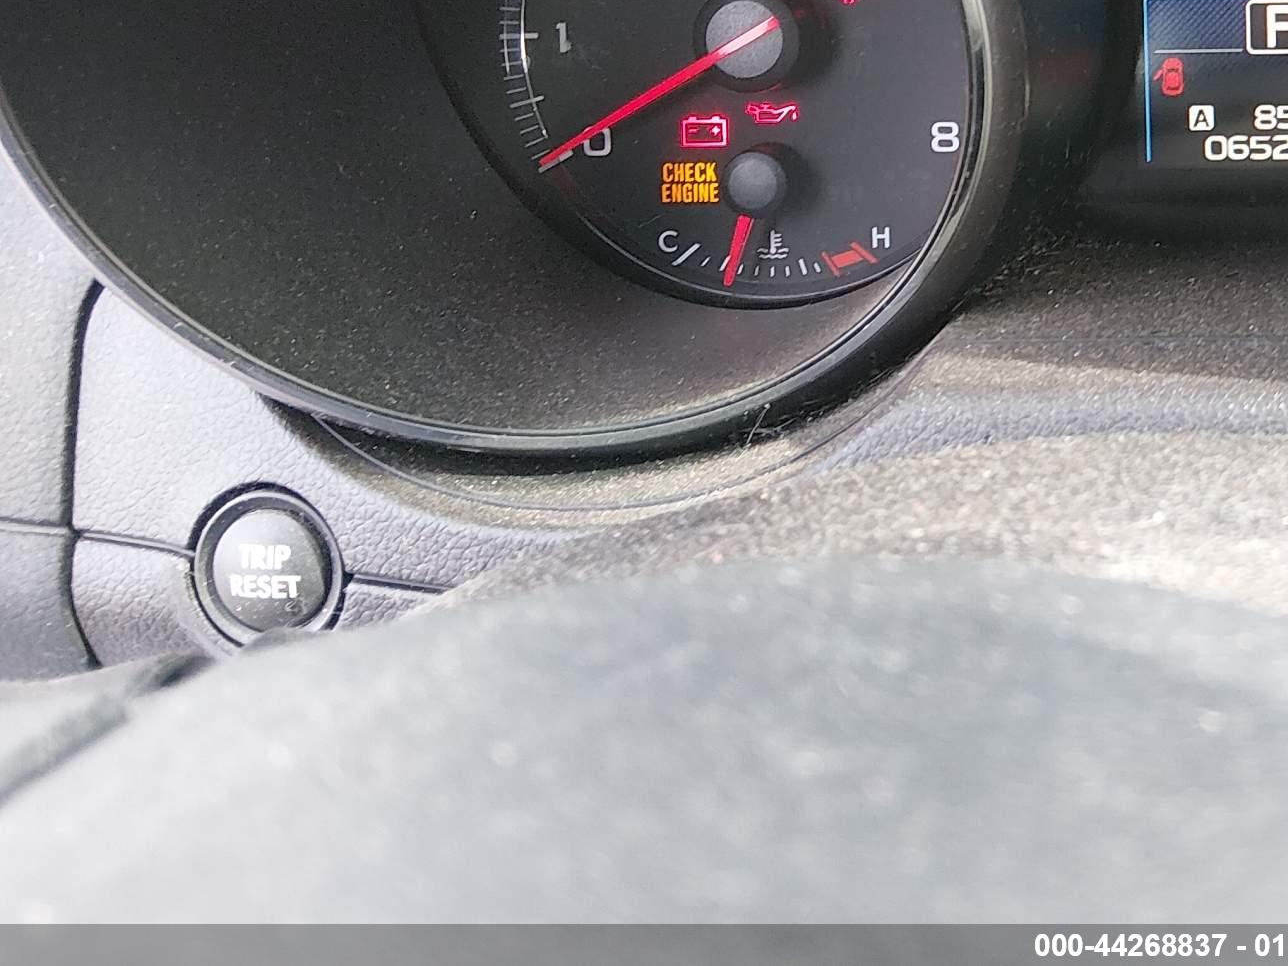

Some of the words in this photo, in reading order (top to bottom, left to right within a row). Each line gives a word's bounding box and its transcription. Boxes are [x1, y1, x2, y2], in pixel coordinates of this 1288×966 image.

[556, 23, 571, 52] 1
[1193, 108, 1211, 128] A
[583, 125, 611, 156] 0
[932, 122, 959, 152] 8
[662, 162, 717, 182] CHECK
[661, 184, 719, 203] ENGINE
[659, 231, 677, 252] C
[872, 227, 889, 248] H
[238, 544, 292, 570] TRIP
[229, 573, 300, 598] RESET
